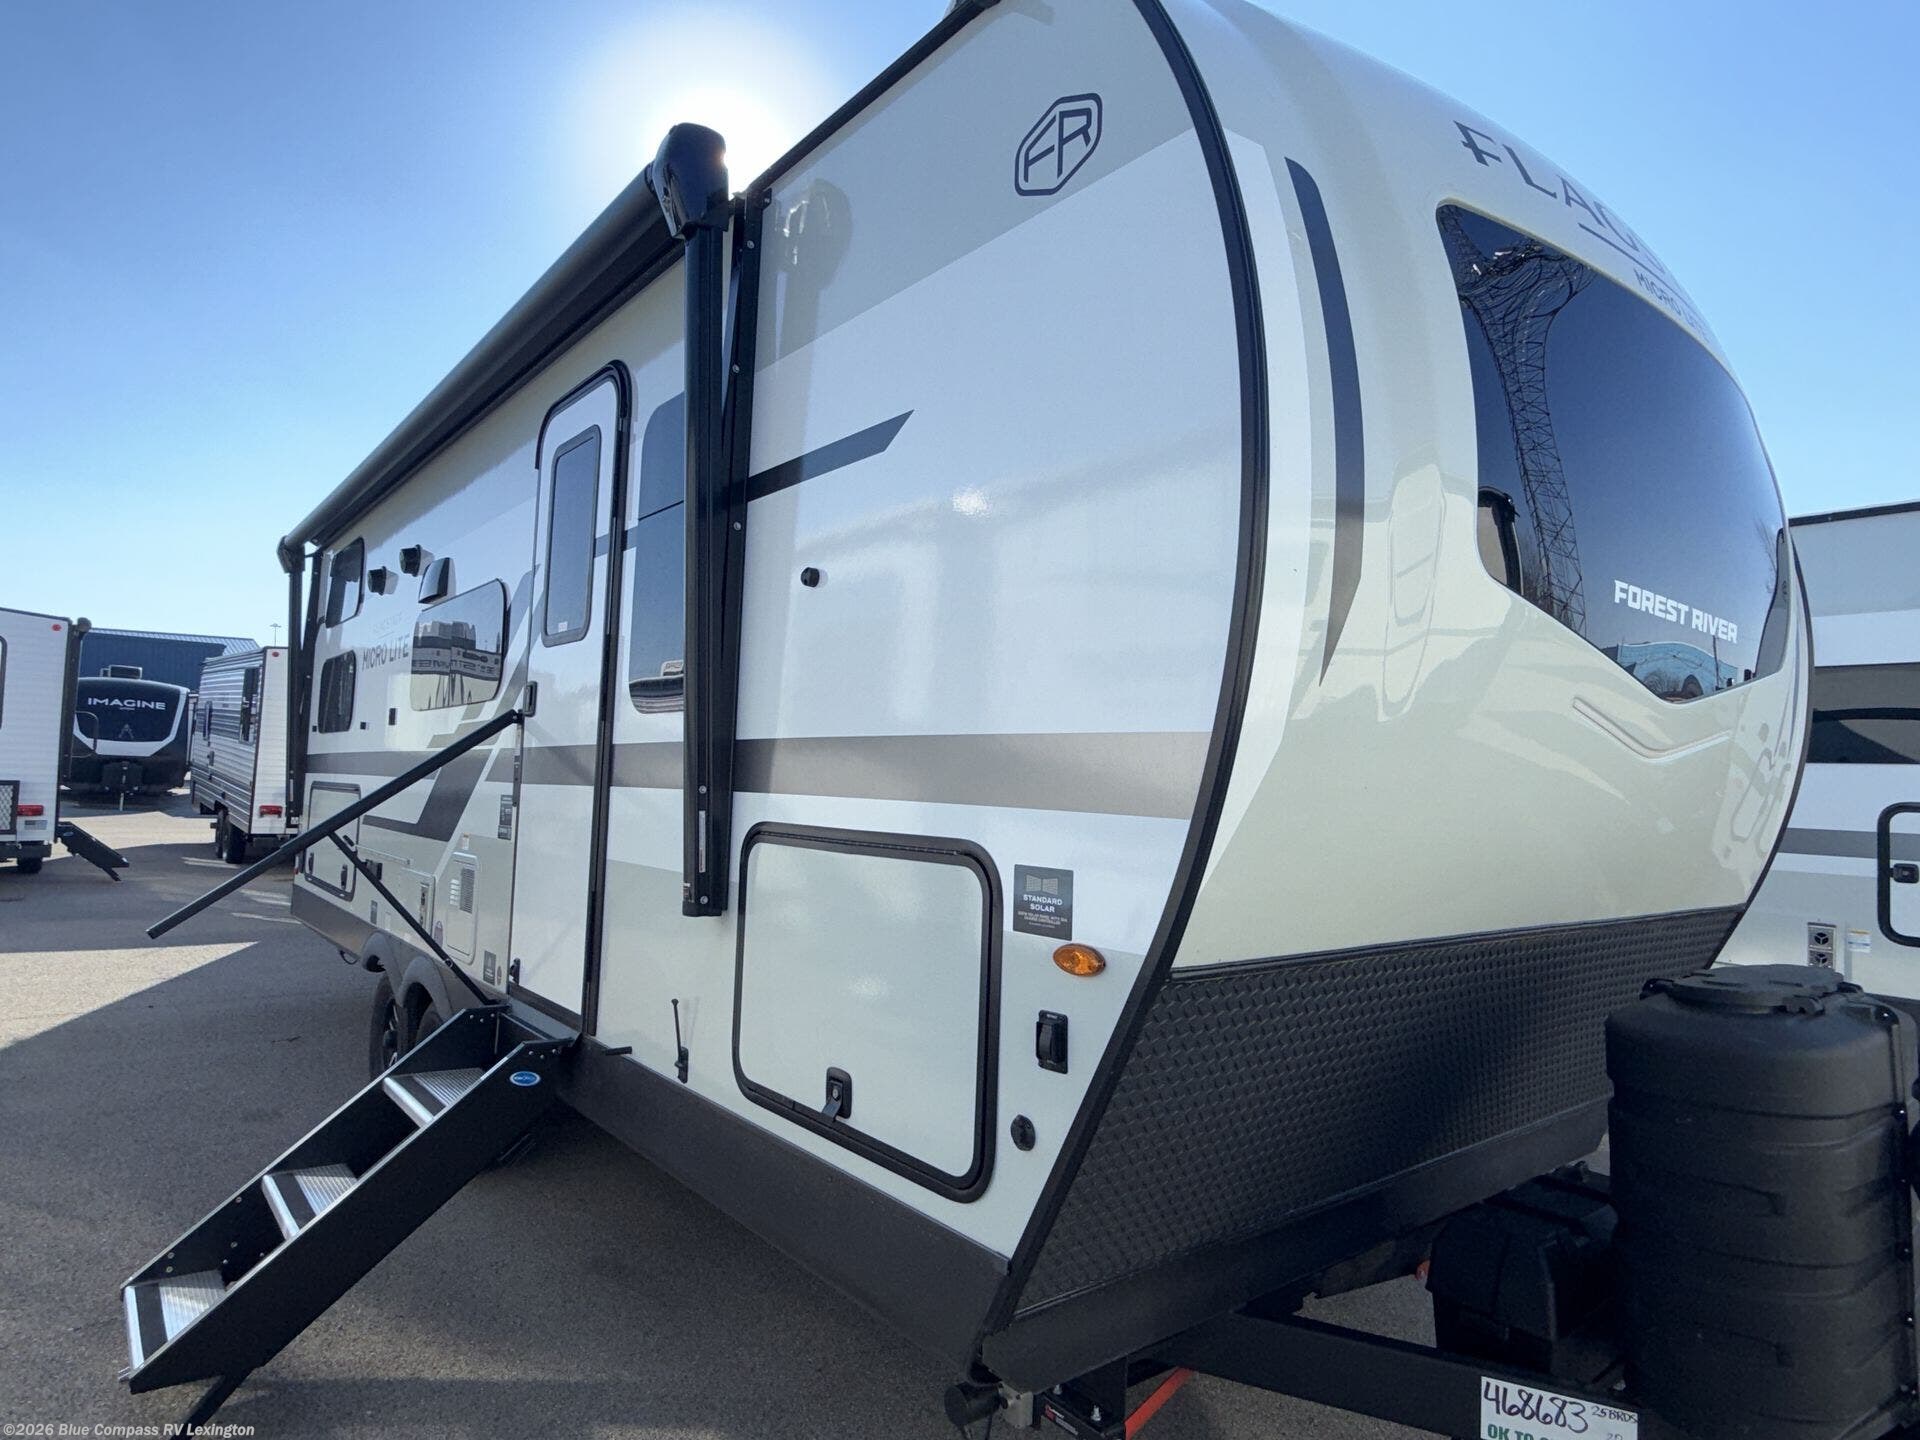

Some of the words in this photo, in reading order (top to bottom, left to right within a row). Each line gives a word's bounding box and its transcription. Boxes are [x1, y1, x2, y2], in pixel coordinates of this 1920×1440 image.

[1614, 580, 1689, 625] FOREST
[1691, 607, 1738, 644] RIVER
[363, 643, 388, 670] MICRO
[389, 633, 410, 662] LITE
[87, 697, 167, 710] IMAGINE
[1023, 894, 1063, 906] STANDARD
[1030, 903, 1055, 913] SOLAR
[1483, 1381, 1589, 1434] 468683
[1487, 1423, 1511, 1440] OK
